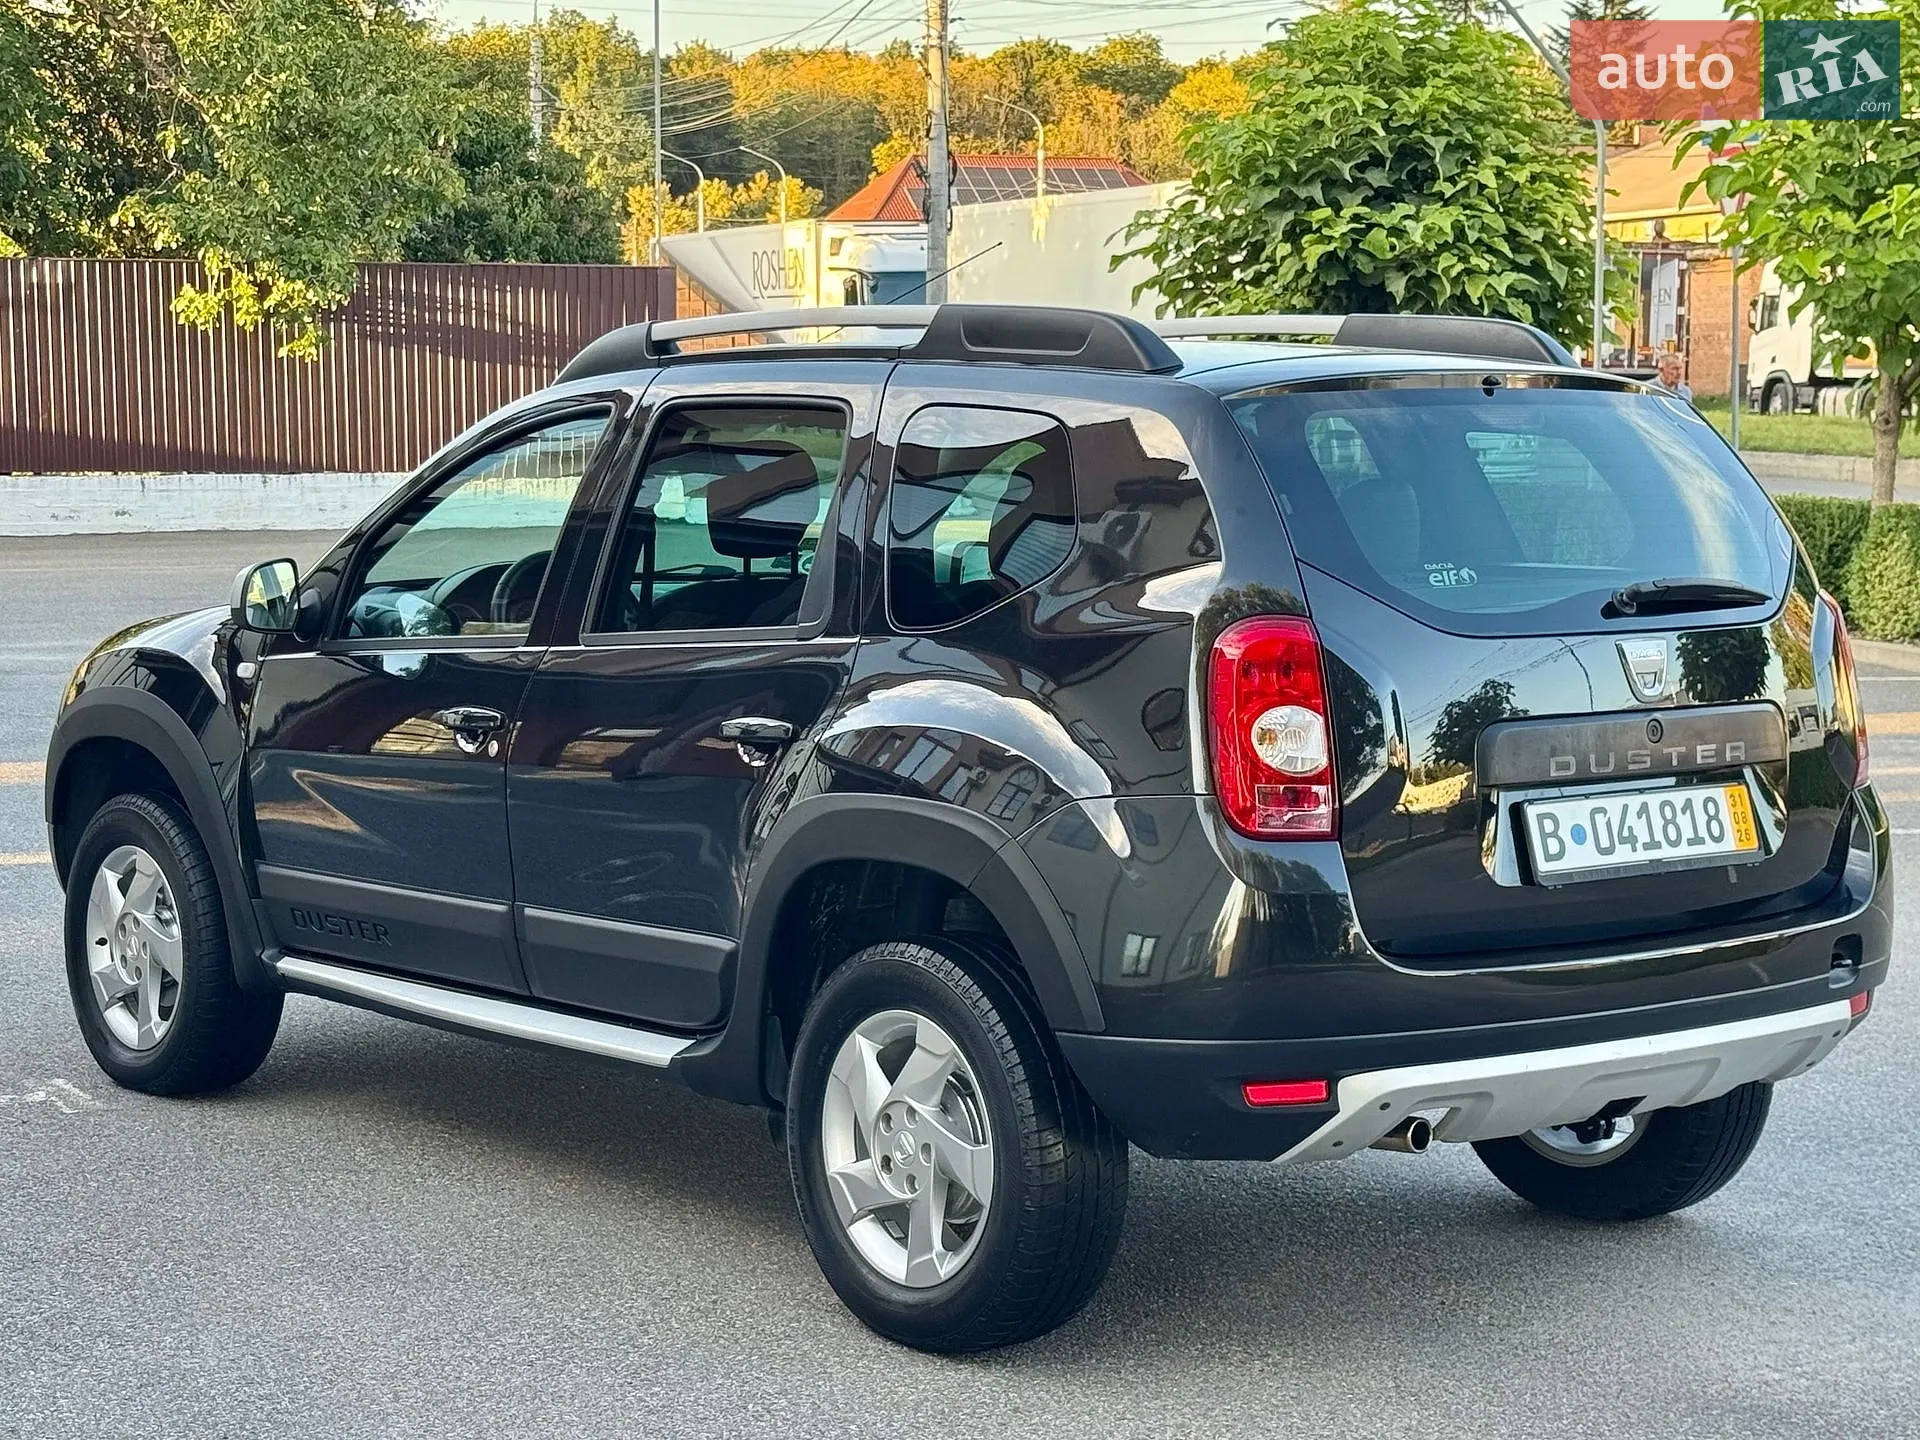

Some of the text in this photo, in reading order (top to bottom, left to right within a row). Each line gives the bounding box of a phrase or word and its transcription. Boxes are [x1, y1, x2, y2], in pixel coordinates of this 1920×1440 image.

[752, 248, 805, 299] ROSHEN
[1429, 570, 1458, 586] elf
[1550, 742, 1746, 776] DUSTER
[1729, 792, 1743, 808] 31
[1536, 795, 1725, 863] B 041818
[1733, 811, 1748, 825] 08
[1736, 828, 1751, 842] 26
[290, 907, 392, 946] DUSTER
